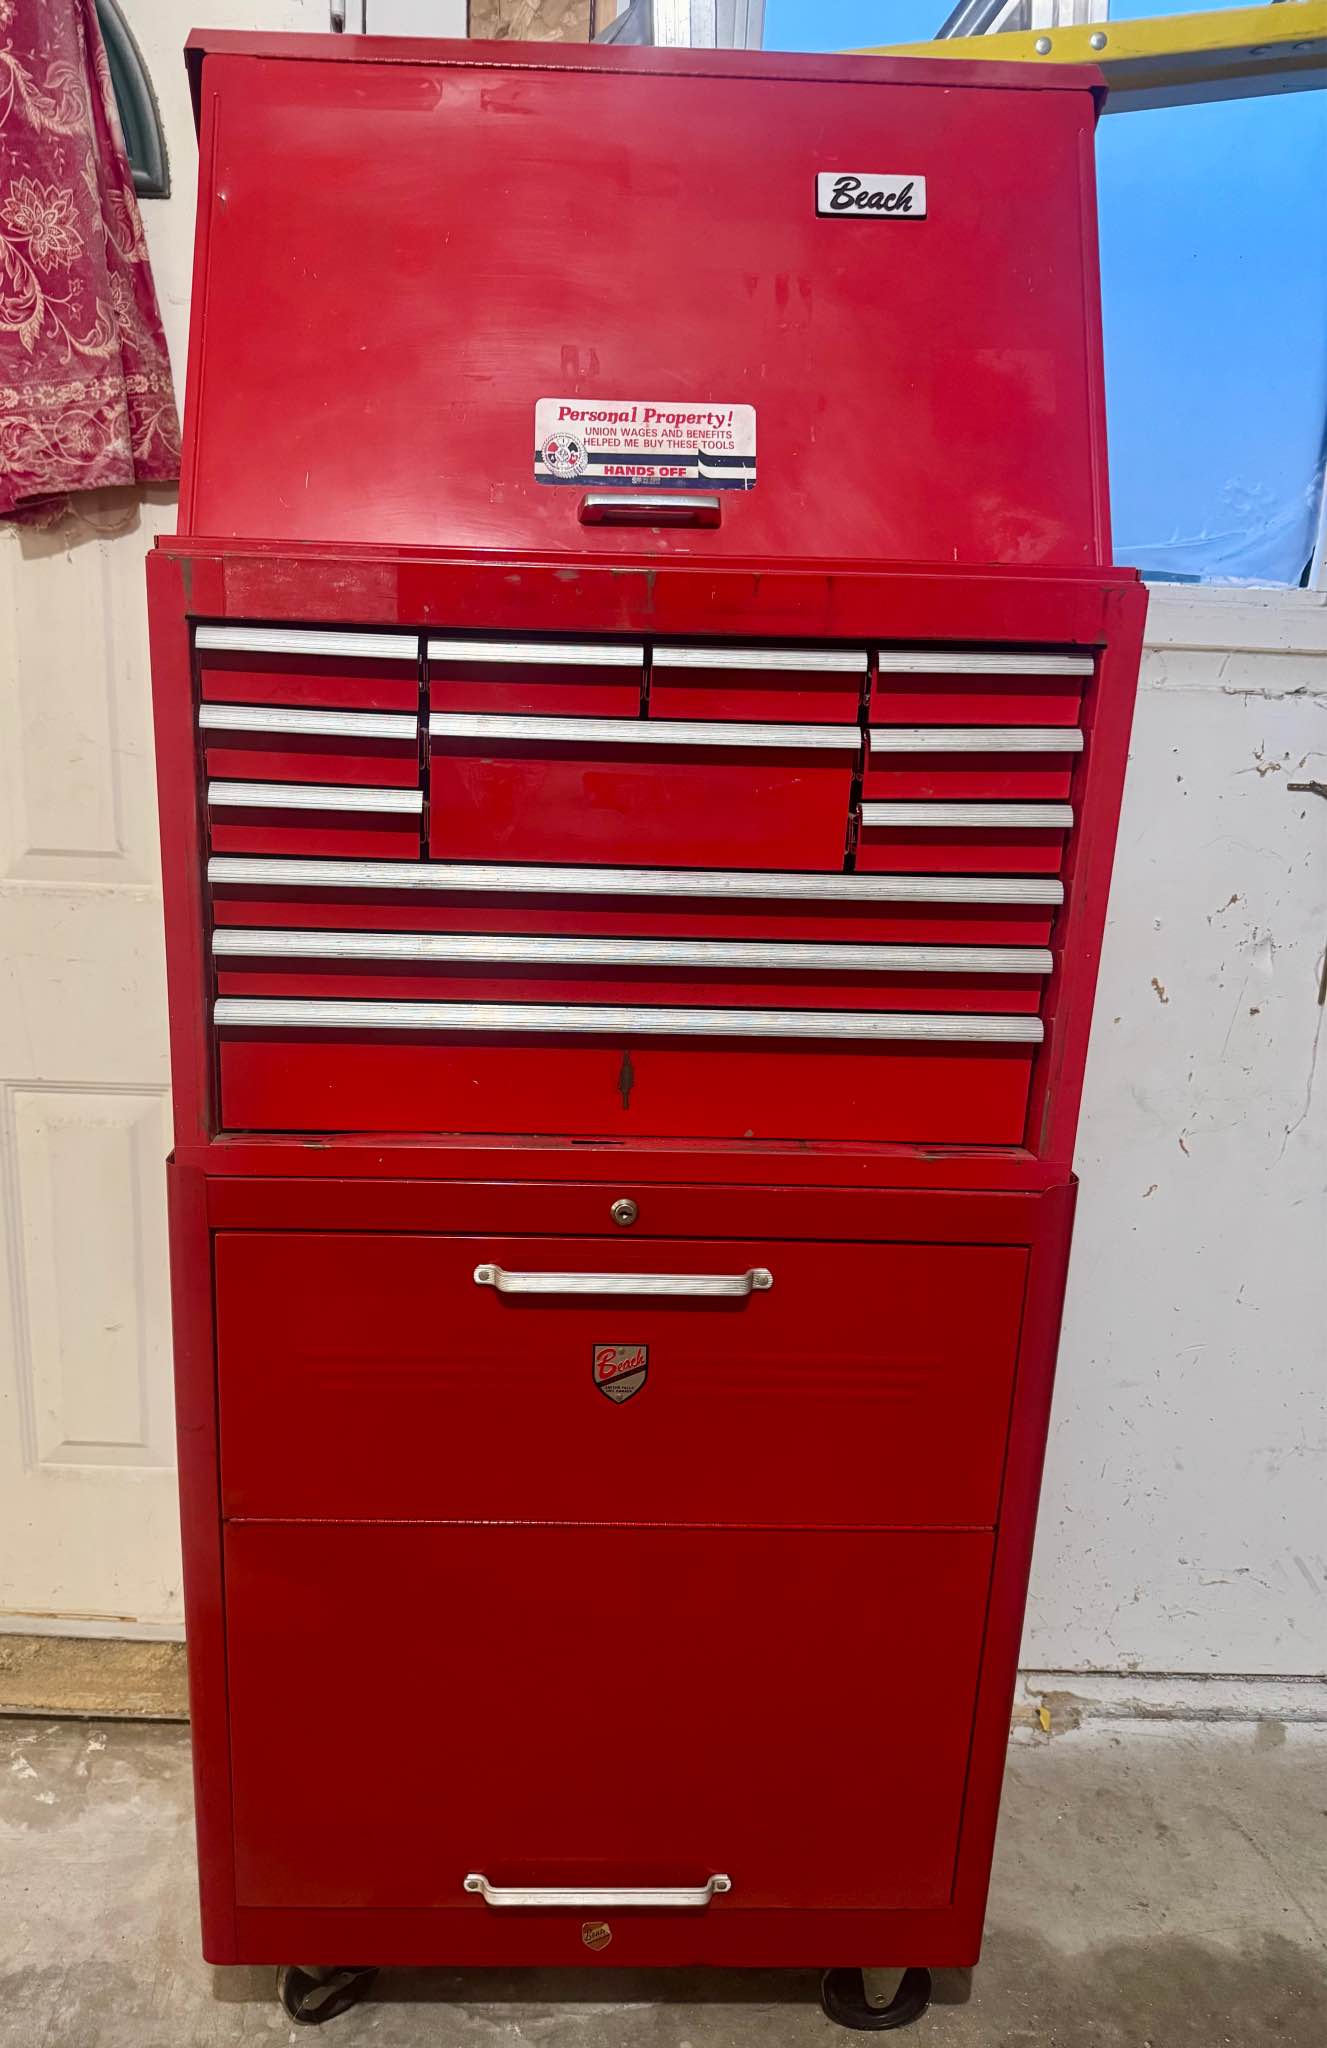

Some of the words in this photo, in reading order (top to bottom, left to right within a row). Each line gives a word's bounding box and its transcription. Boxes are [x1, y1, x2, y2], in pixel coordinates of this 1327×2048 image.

[830, 176, 914, 212] Beach
[558, 406, 638, 424] Personal
[643, 408, 734, 429] Property!
[585, 427, 617, 437] UNION
[620, 428, 658, 438] WAGES
[661, 429, 683, 438] AND
[686, 430, 733, 439] BENEFITS
[583, 437, 621, 447] HELPED
[624, 439, 640, 448] ME
[643, 439, 664, 448] BUY
[666, 440, 698, 449] THESE
[700, 440, 735, 450] TOOLS
[603, 465, 655, 476] HANDS
[659, 467, 687, 477] OFF
[597, 1347, 645, 1380] Beach
